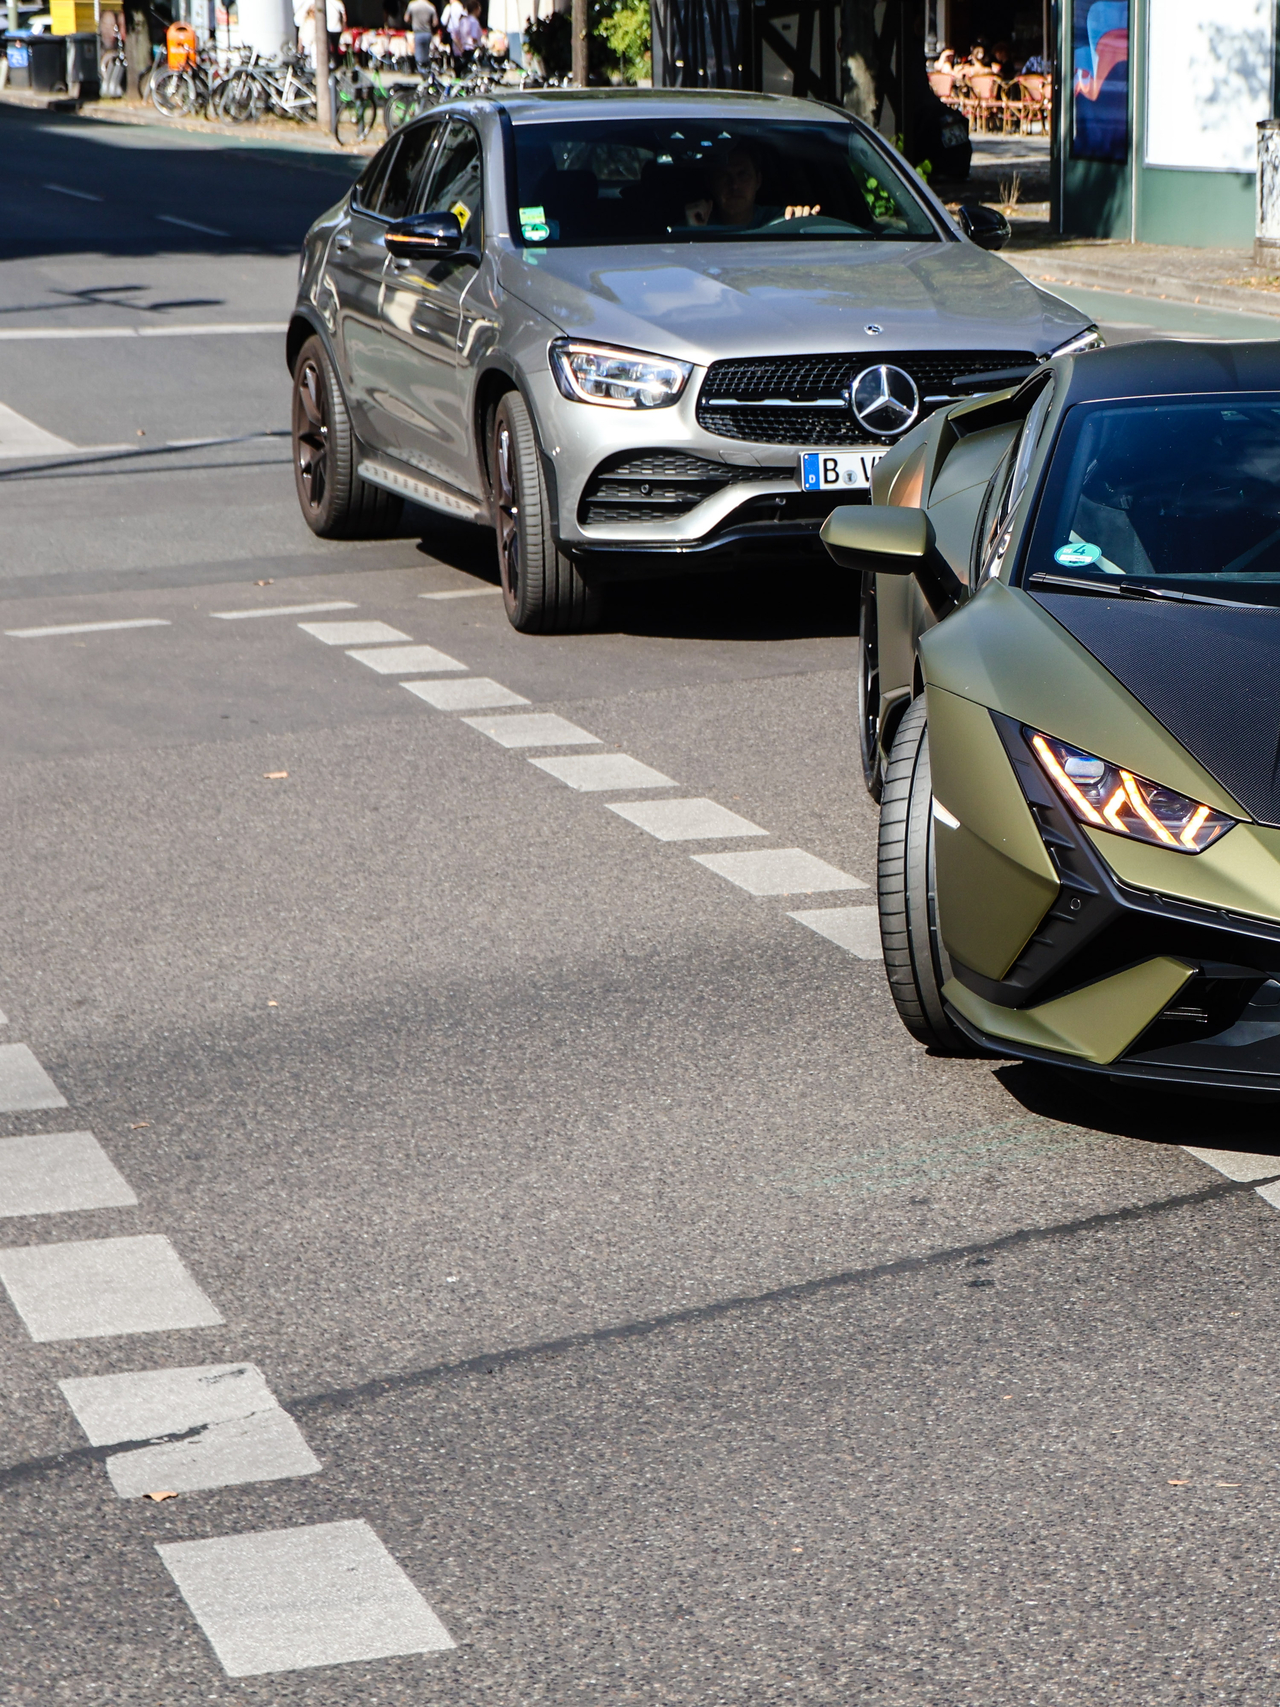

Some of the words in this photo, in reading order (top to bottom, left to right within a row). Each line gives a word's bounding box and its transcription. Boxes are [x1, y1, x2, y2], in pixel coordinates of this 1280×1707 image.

[823, 458, 839, 484] B
[860, 456, 883, 482] V
[809, 474, 816, 484] D
[1073, 544, 1086, 555] 4
